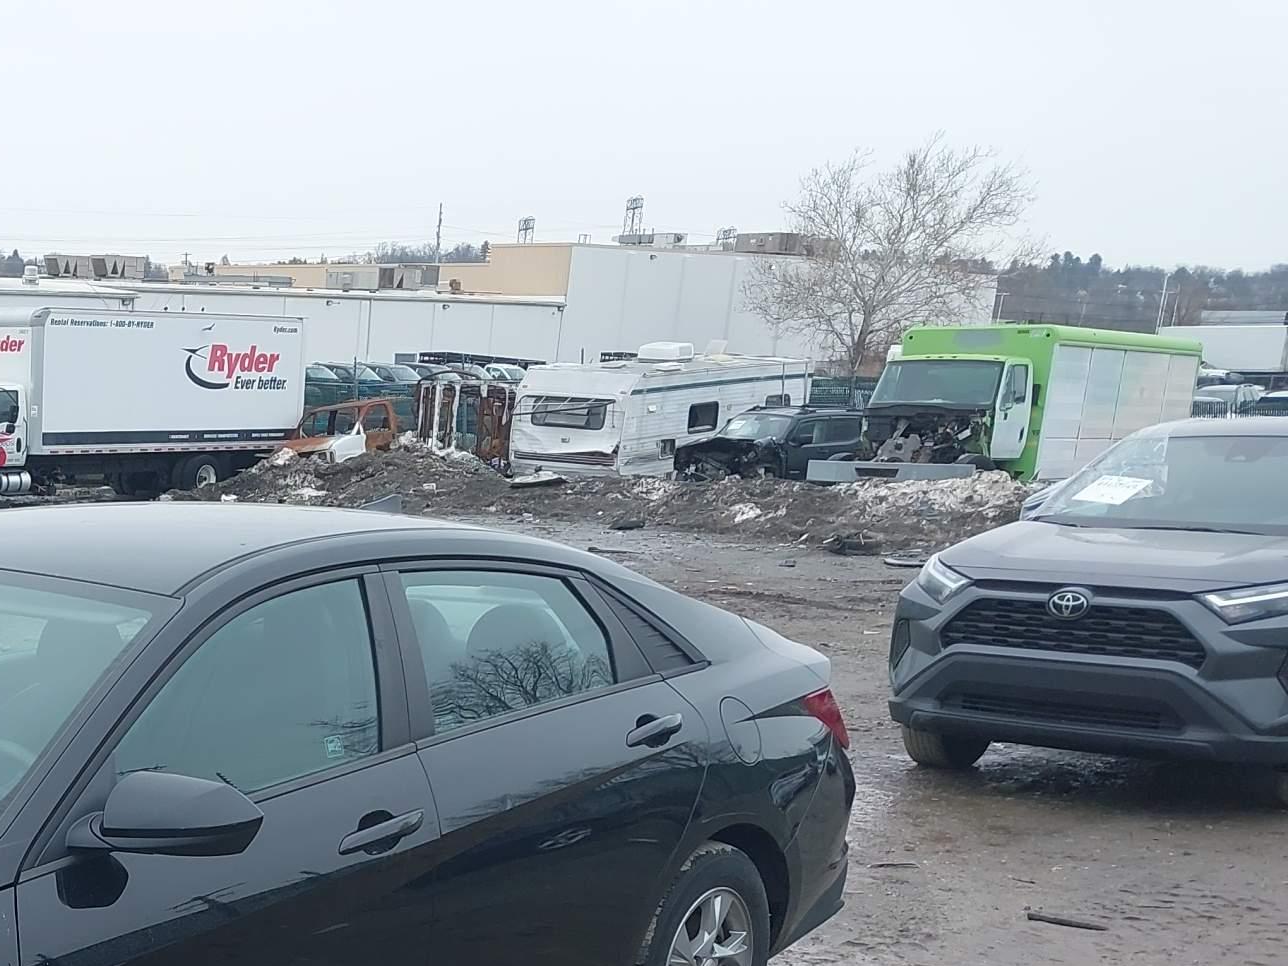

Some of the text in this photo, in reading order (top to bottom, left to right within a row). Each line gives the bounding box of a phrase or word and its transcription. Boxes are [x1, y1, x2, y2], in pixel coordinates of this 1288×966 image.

[50, 318, 69, 327] Rental
[70, 319, 109, 328] Reservations:
[207, 344, 280, 379] Ryder
[234, 376, 287, 390] Ever better.
